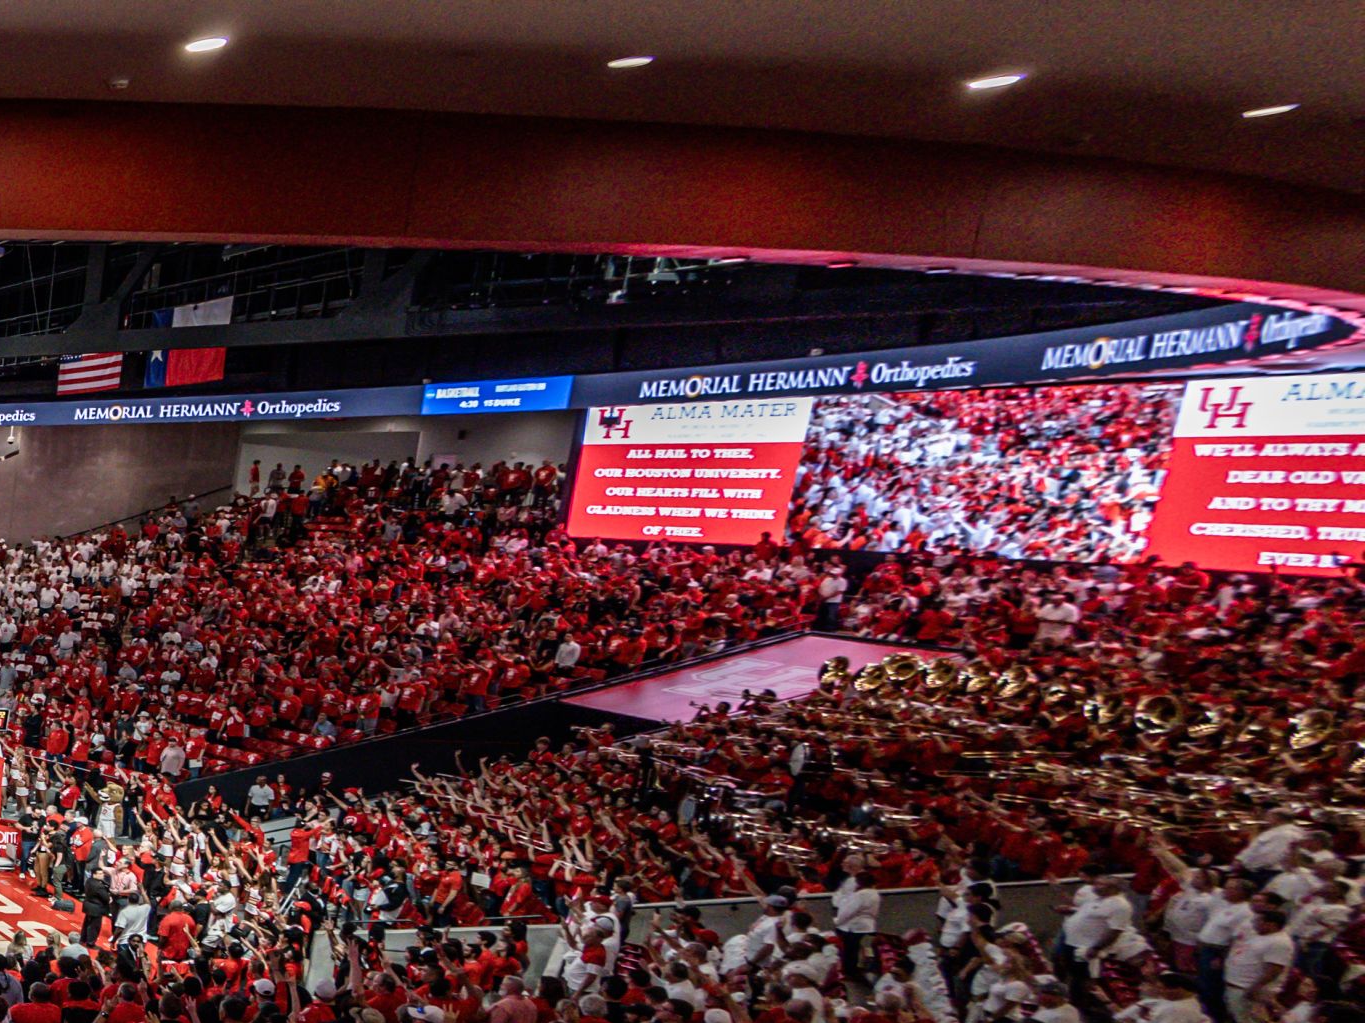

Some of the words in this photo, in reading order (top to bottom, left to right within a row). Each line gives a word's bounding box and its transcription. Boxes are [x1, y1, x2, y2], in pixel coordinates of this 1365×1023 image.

[1041, 335, 1149, 370] MEMORIAL
[1149, 320, 1249, 359] HERMANN
[639, 376, 742, 398] MEMORIAL
[747, 366, 852, 392] HERMANN
[870, 357, 977, 387] Orthopedics
[74, 405, 154, 421] MEMORIAL
[159, 402, 239, 418] HERMANN
[257, 399, 341, 417] Orthopedics
[651, 406, 712, 421] ALMA
[720, 403, 798, 419] MATER
[1197, 386, 1254, 428] UH
[626, 449, 653, 459] ALL
[654, 449, 688, 459] HAIL
[690, 449, 711, 459] TO
[1259, 443, 1353, 456] ALWAYS
[594, 468, 624, 478] OUR
[624, 468, 693, 479] HOUSTON
[1226, 470, 1288, 484] DEAR
[1288, 470, 1338, 484] OLD
[605, 487, 636, 497] OUR
[636, 487, 689, 498] HEARTS
[690, 488, 720, 498] FILL
[722, 488, 764, 499] WITH
[1207, 497, 1257, 510] AND
[1259, 497, 1292, 511] TO
[1294, 498, 1339, 512] THY
[586, 505, 656, 516] GLADNESS
[657, 507, 701, 518] WHEN
[704, 508, 729, 518] WE
[730, 508, 777, 520] THINK
[643, 525, 663, 536] OF
[1257, 551, 1317, 565] EVER
